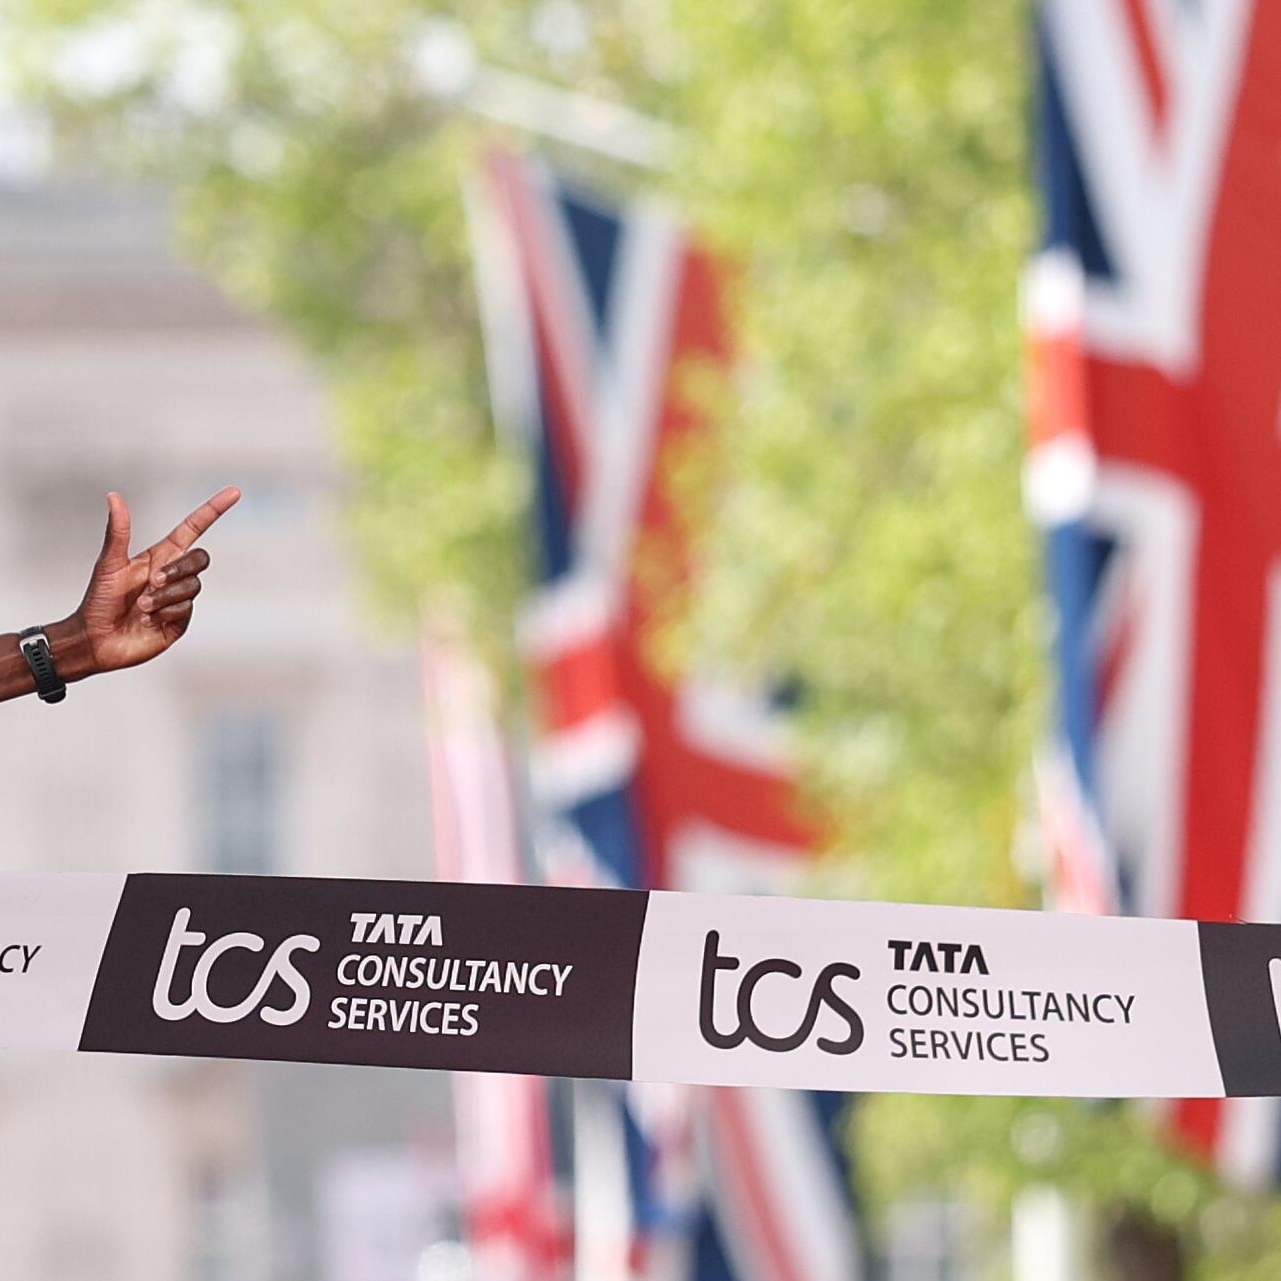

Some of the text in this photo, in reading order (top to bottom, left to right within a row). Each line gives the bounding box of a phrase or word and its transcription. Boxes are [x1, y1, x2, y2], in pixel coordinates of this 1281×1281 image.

[351, 912, 443, 947] TATA
[152, 907, 321, 1026] tcs
[338, 955, 574, 997] CONSULTANCY
[888, 939, 990, 976] TATA
[699, 929, 865, 1056] tcs
[887, 984, 1135, 1024] CONSULTANCY
[328, 998, 479, 1036] SERVICES
[890, 1028, 1050, 1063] SERVICES
